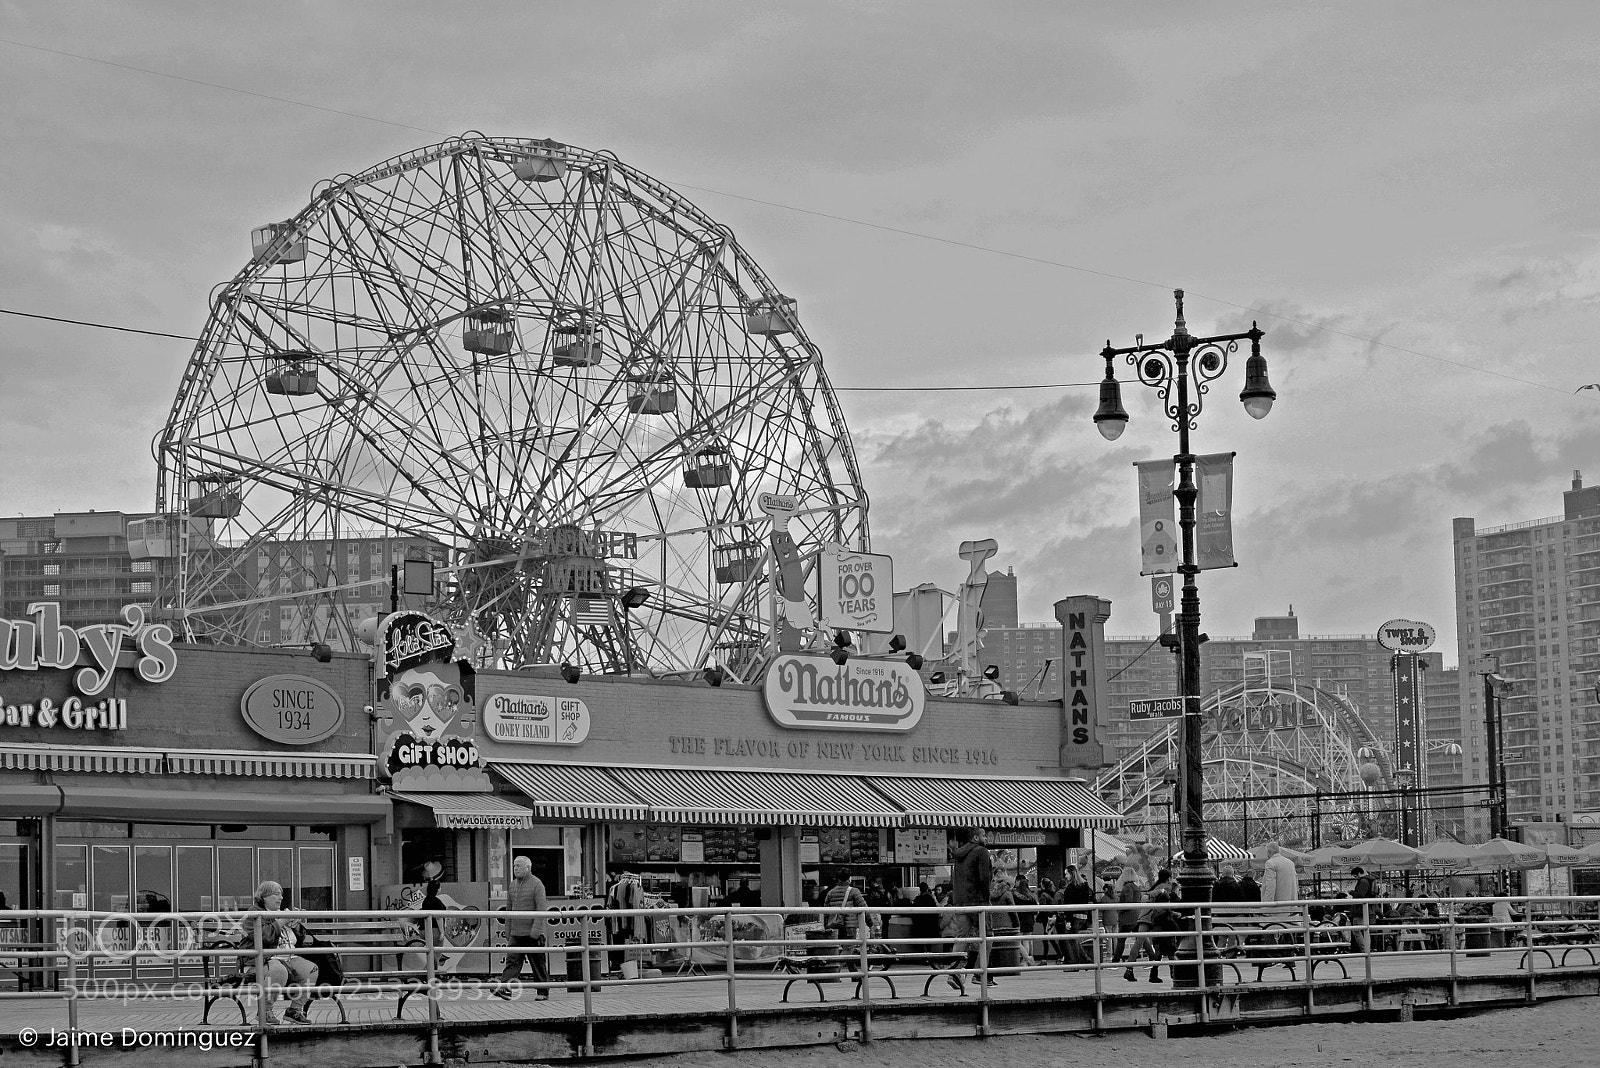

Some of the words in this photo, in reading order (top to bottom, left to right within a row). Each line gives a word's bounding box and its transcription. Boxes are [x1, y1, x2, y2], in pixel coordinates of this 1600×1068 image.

[838, 564, 853, 574] FOR
[854, 562, 873, 572] OVER
[838, 573, 875, 599] 100
[838, 598, 876, 614] YEARS
[416, 620, 453, 652] Star
[856, 667, 872, 676] Since
[873, 668, 885, 676] 1916
[1069, 612, 1089, 745] NATHANS
[778, 659, 910, 709] Nathan's
[273, 689, 315, 710] SINCE
[495, 696, 549, 716] Nathan's
[561, 701, 580, 711] GIFT
[1131, 701, 1151, 715] Ruby
[1153, 699, 1181, 711] Jacobs
[0, 695, 34, 728] ar
[38, 697, 59, 729] &
[62, 696, 128, 731] Grill
[278, 711, 311, 731] 1934
[561, 712, 580, 720] SHOP
[826, 713, 870, 722] FAMOUS
[495, 723, 520, 737] CONEY
[522, 724, 550, 739] ISLAND
[437, 745, 478, 765] SHOP
[669, 736, 705, 754] THE
[714, 738, 780, 758] FLAVOR
[788, 741, 809, 758] OF
[818, 741, 853, 760] NEW
[862, 744, 906, 762] YORK
[913, 746, 959, 764] SINCE
[966, 748, 999, 766] 1916
[448, 816, 522, 826] WWW.LOLASTAR.COM
